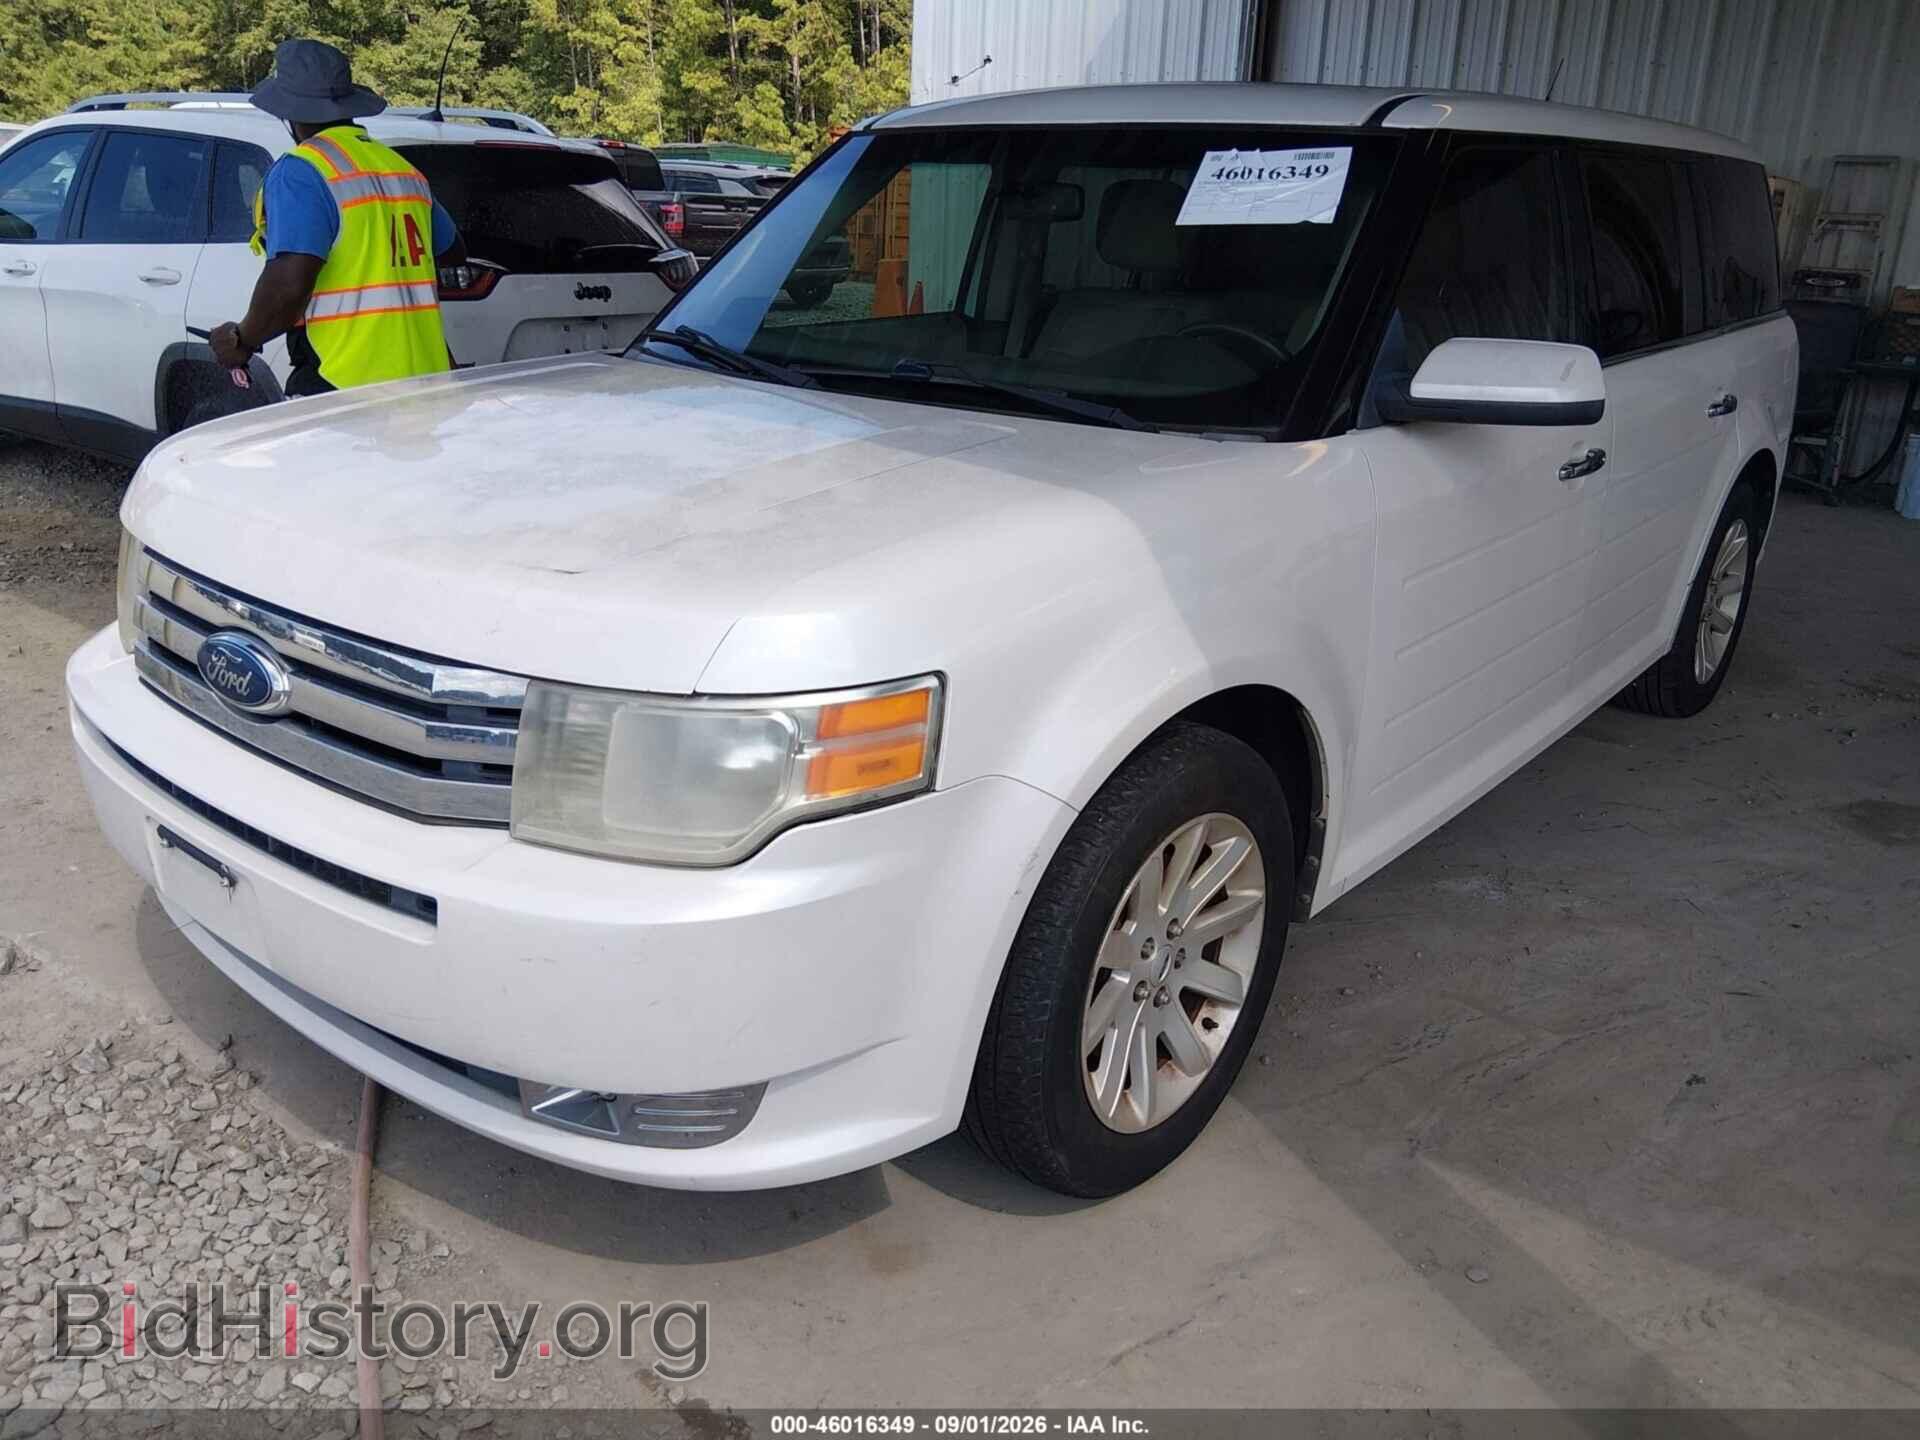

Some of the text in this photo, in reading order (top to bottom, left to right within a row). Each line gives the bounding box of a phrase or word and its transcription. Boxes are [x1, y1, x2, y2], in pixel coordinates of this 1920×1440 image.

[1210, 163, 1330, 181] 46016349
[573, 281, 612, 303] Jeep
[206, 647, 253, 697] Ford
